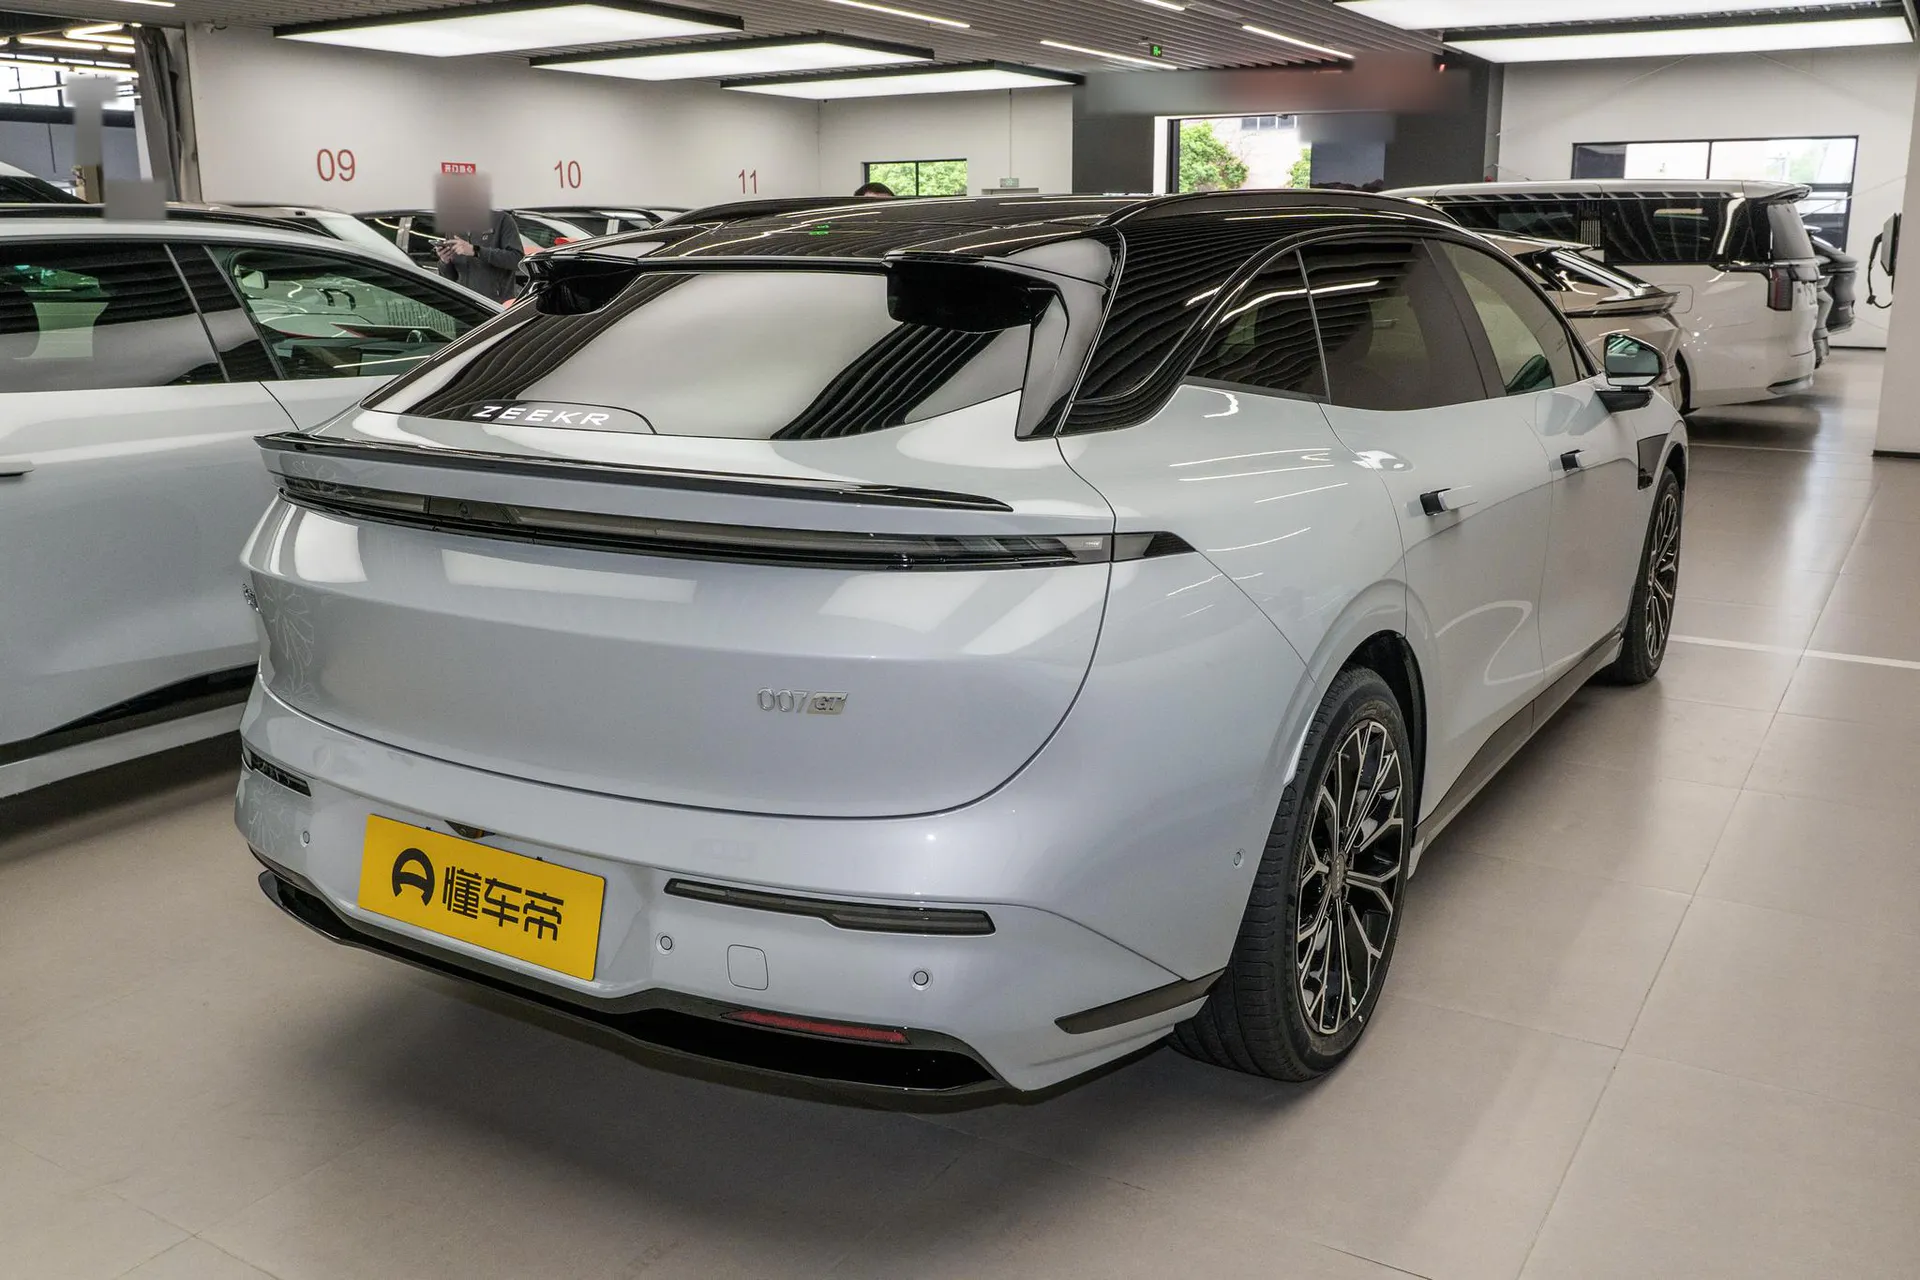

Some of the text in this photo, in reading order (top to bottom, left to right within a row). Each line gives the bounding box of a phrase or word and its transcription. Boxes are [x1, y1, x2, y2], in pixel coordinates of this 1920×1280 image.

[316, 148, 356, 182] 09
[554, 160, 582, 189] 10
[738, 169, 757, 195] 11
[472, 405, 610, 426] ZEEKR
[442, 866, 564, 941] 懂车帝
